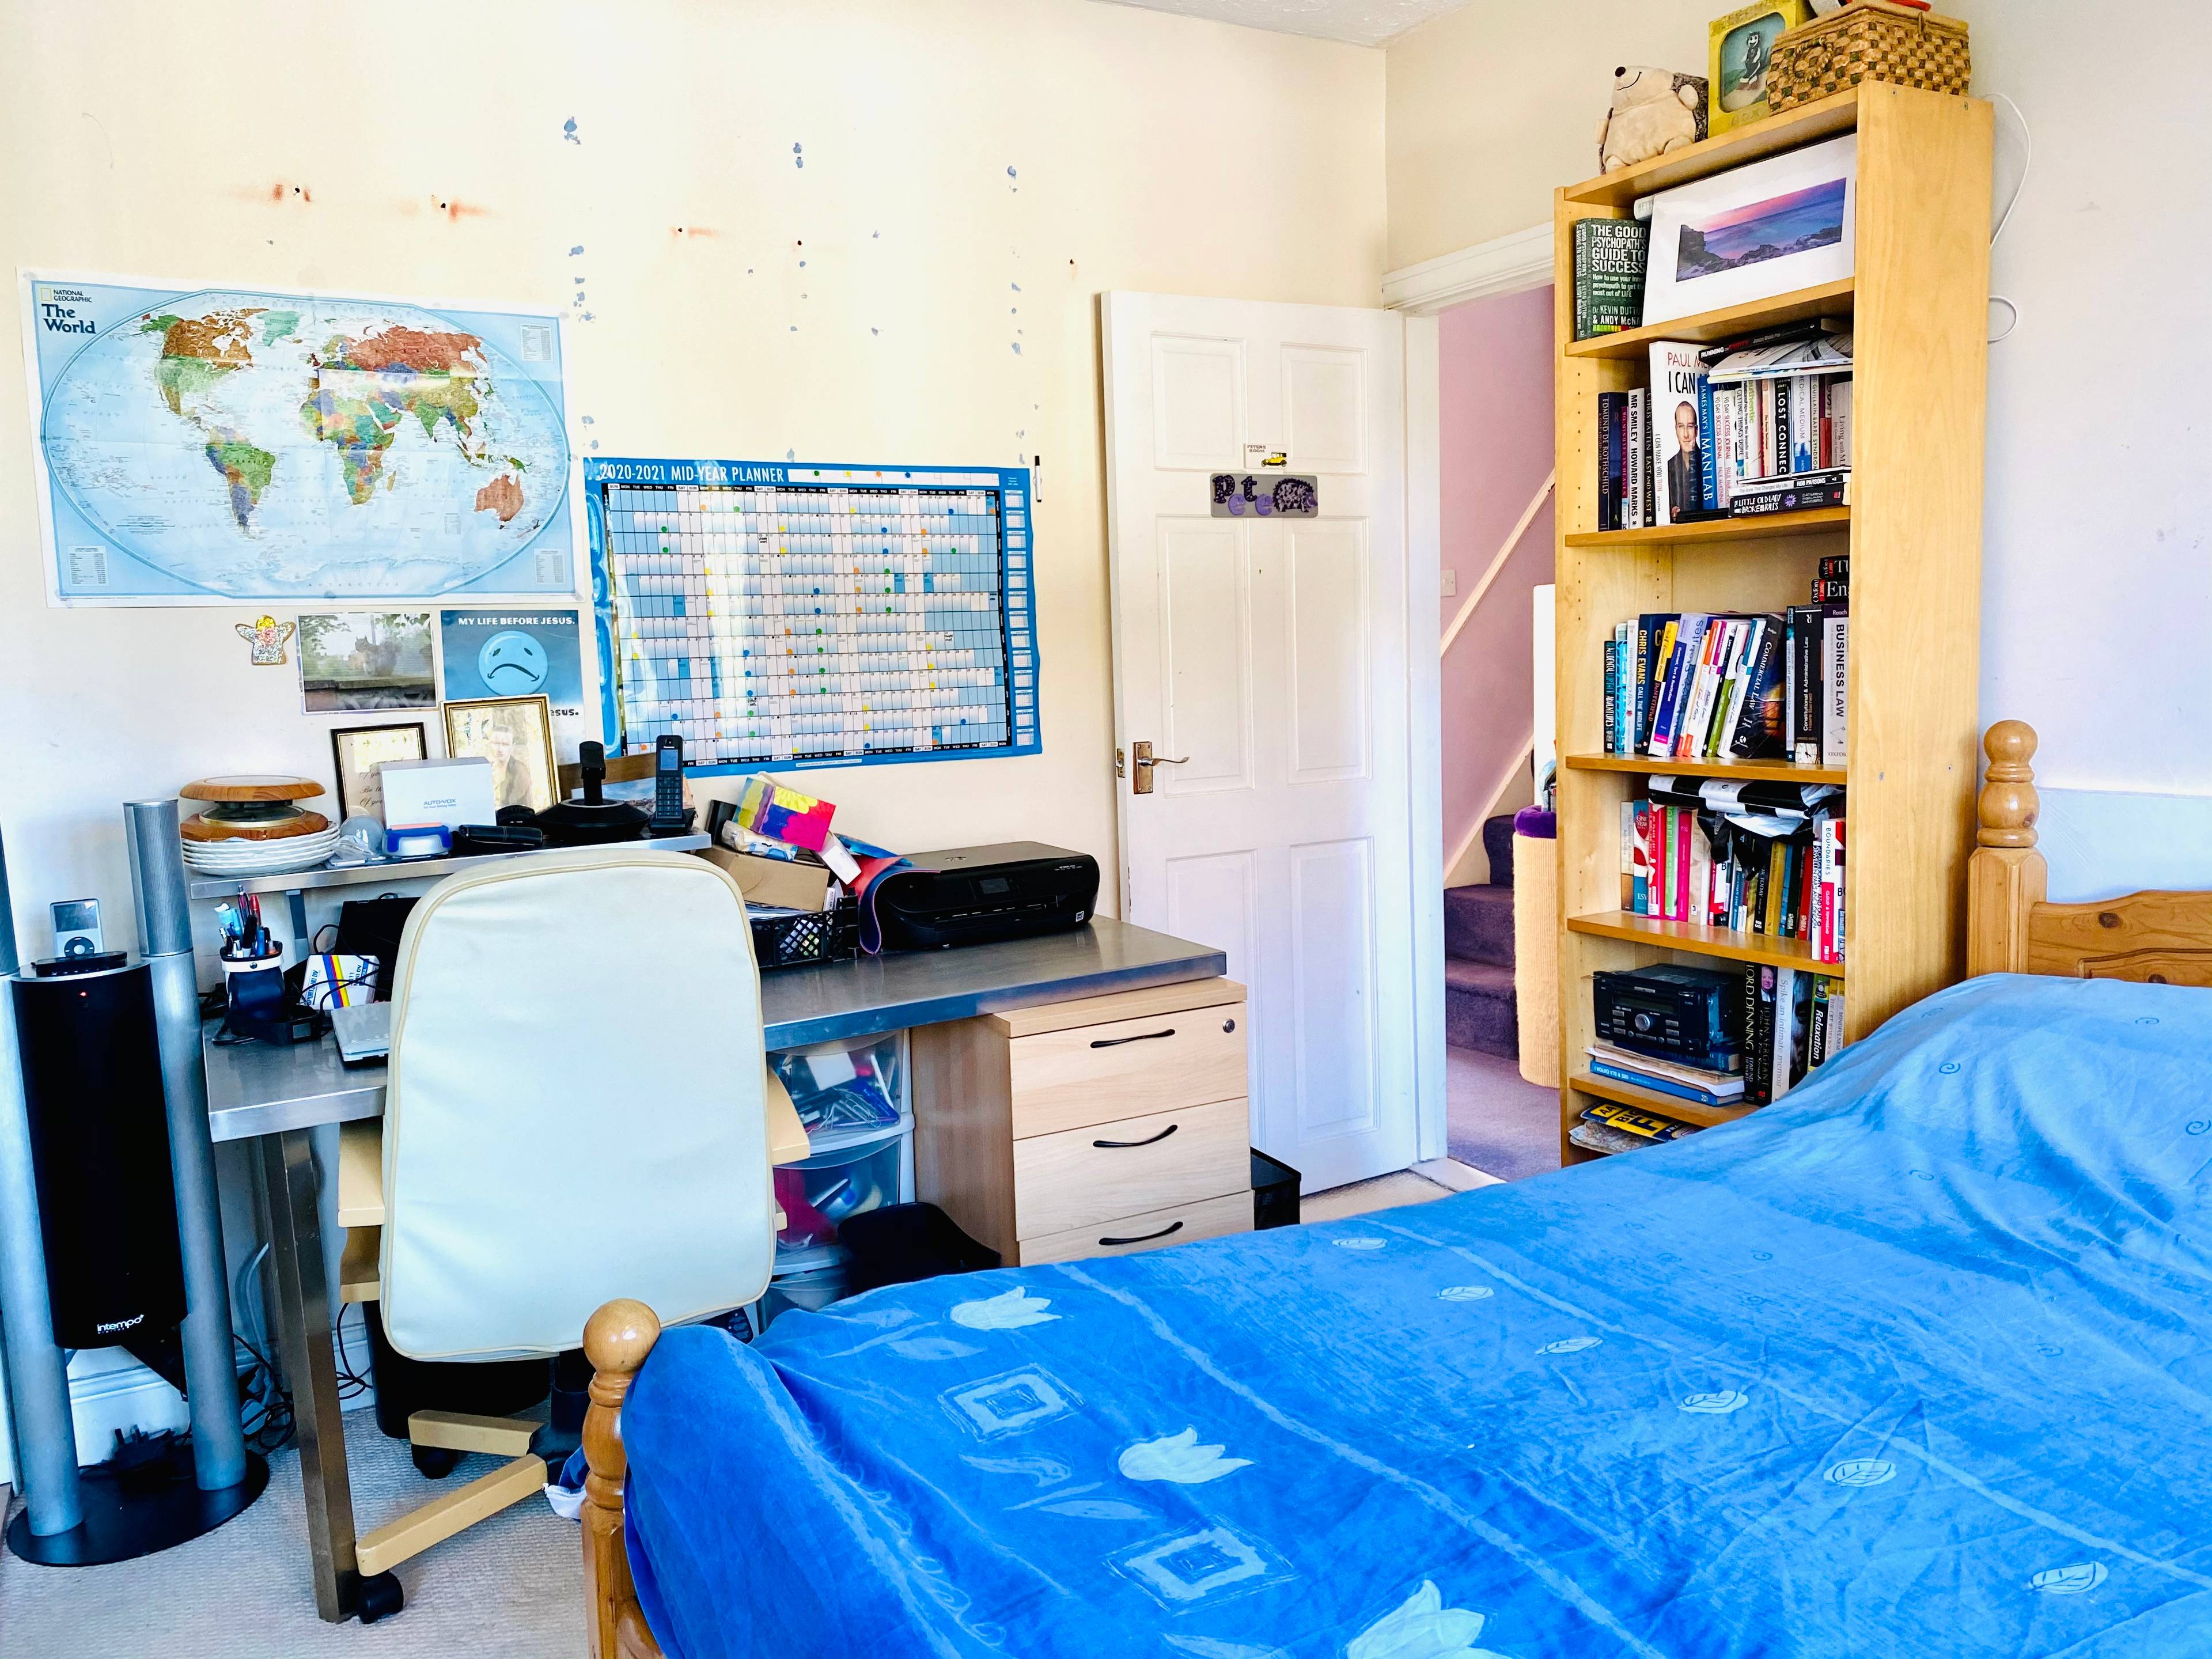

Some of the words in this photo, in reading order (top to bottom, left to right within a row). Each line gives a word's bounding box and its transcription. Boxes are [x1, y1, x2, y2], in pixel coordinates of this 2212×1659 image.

[1591, 224, 1612, 237] THE
[1615, 226, 1646, 238] GOOD
[1591, 237, 1646, 250] PSYCHOPATH'S
[1592, 248, 1628, 261] GUIDE
[1631, 249, 1646, 262] TO
[1592, 259, 1646, 274] SUCCESS
[1627, 283, 1636, 291] get
[54, 295, 92, 303] GEOGRAPHIC
[41, 304, 75, 318] The
[1600, 305, 1618, 315] KEVIN
[43, 318, 96, 334] World
[1593, 315, 1598, 324] &
[1600, 316, 1619, 324] ANDY
[1668, 352, 1691, 367] PAUL
[1701, 347, 1724, 358] RUNNING
[1669, 372, 1672, 393] I
[1676, 371, 1696, 394] CAN
[1631, 395, 1638, 408] MR
[1778, 392, 1786, 419] LOST
[1602, 434, 1609, 444] DE
[1701, 438, 1712, 471] MAN
[1778, 426, 1786, 473] CONNEC
[597, 464, 665, 480] 2020-2021
[671, 465, 728, 482] MID-YEAR
[732, 467, 784, 482] PLANNER
[1703, 476, 1713, 501] LAB
[1805, 478, 1826, 486] PARSONS
[1757, 495, 1768, 505] OLD
[500, 617, 539, 625] BEFORE
[541, 617, 575, 625] JESUS.
[1639, 630, 1647, 655] CHRIS
[1836, 624, 1844, 687] BUSINESS
[1637, 658, 1646, 685] EVANS
[1755, 642, 1772, 691] COMMERCIAL
[1749, 691, 1759, 710] LAW
[1836, 691, 1844, 718] LAW
[550, 708, 579, 716] esus.
[1746, 964, 1754, 994] LORD
[1779, 980, 1788, 1005] Spike
[1780, 1006, 1785, 1016] an
[1745, 998, 1754, 1051] DENNING
[1777, 1017, 1786, 1053] intimate
[1813, 1009, 1824, 1059] Relaxation
[1762, 1037, 1771, 1088] SERGEANT
[1600, 1105, 1616, 1115] AA
[97, 1316, 143, 1332] intempo
